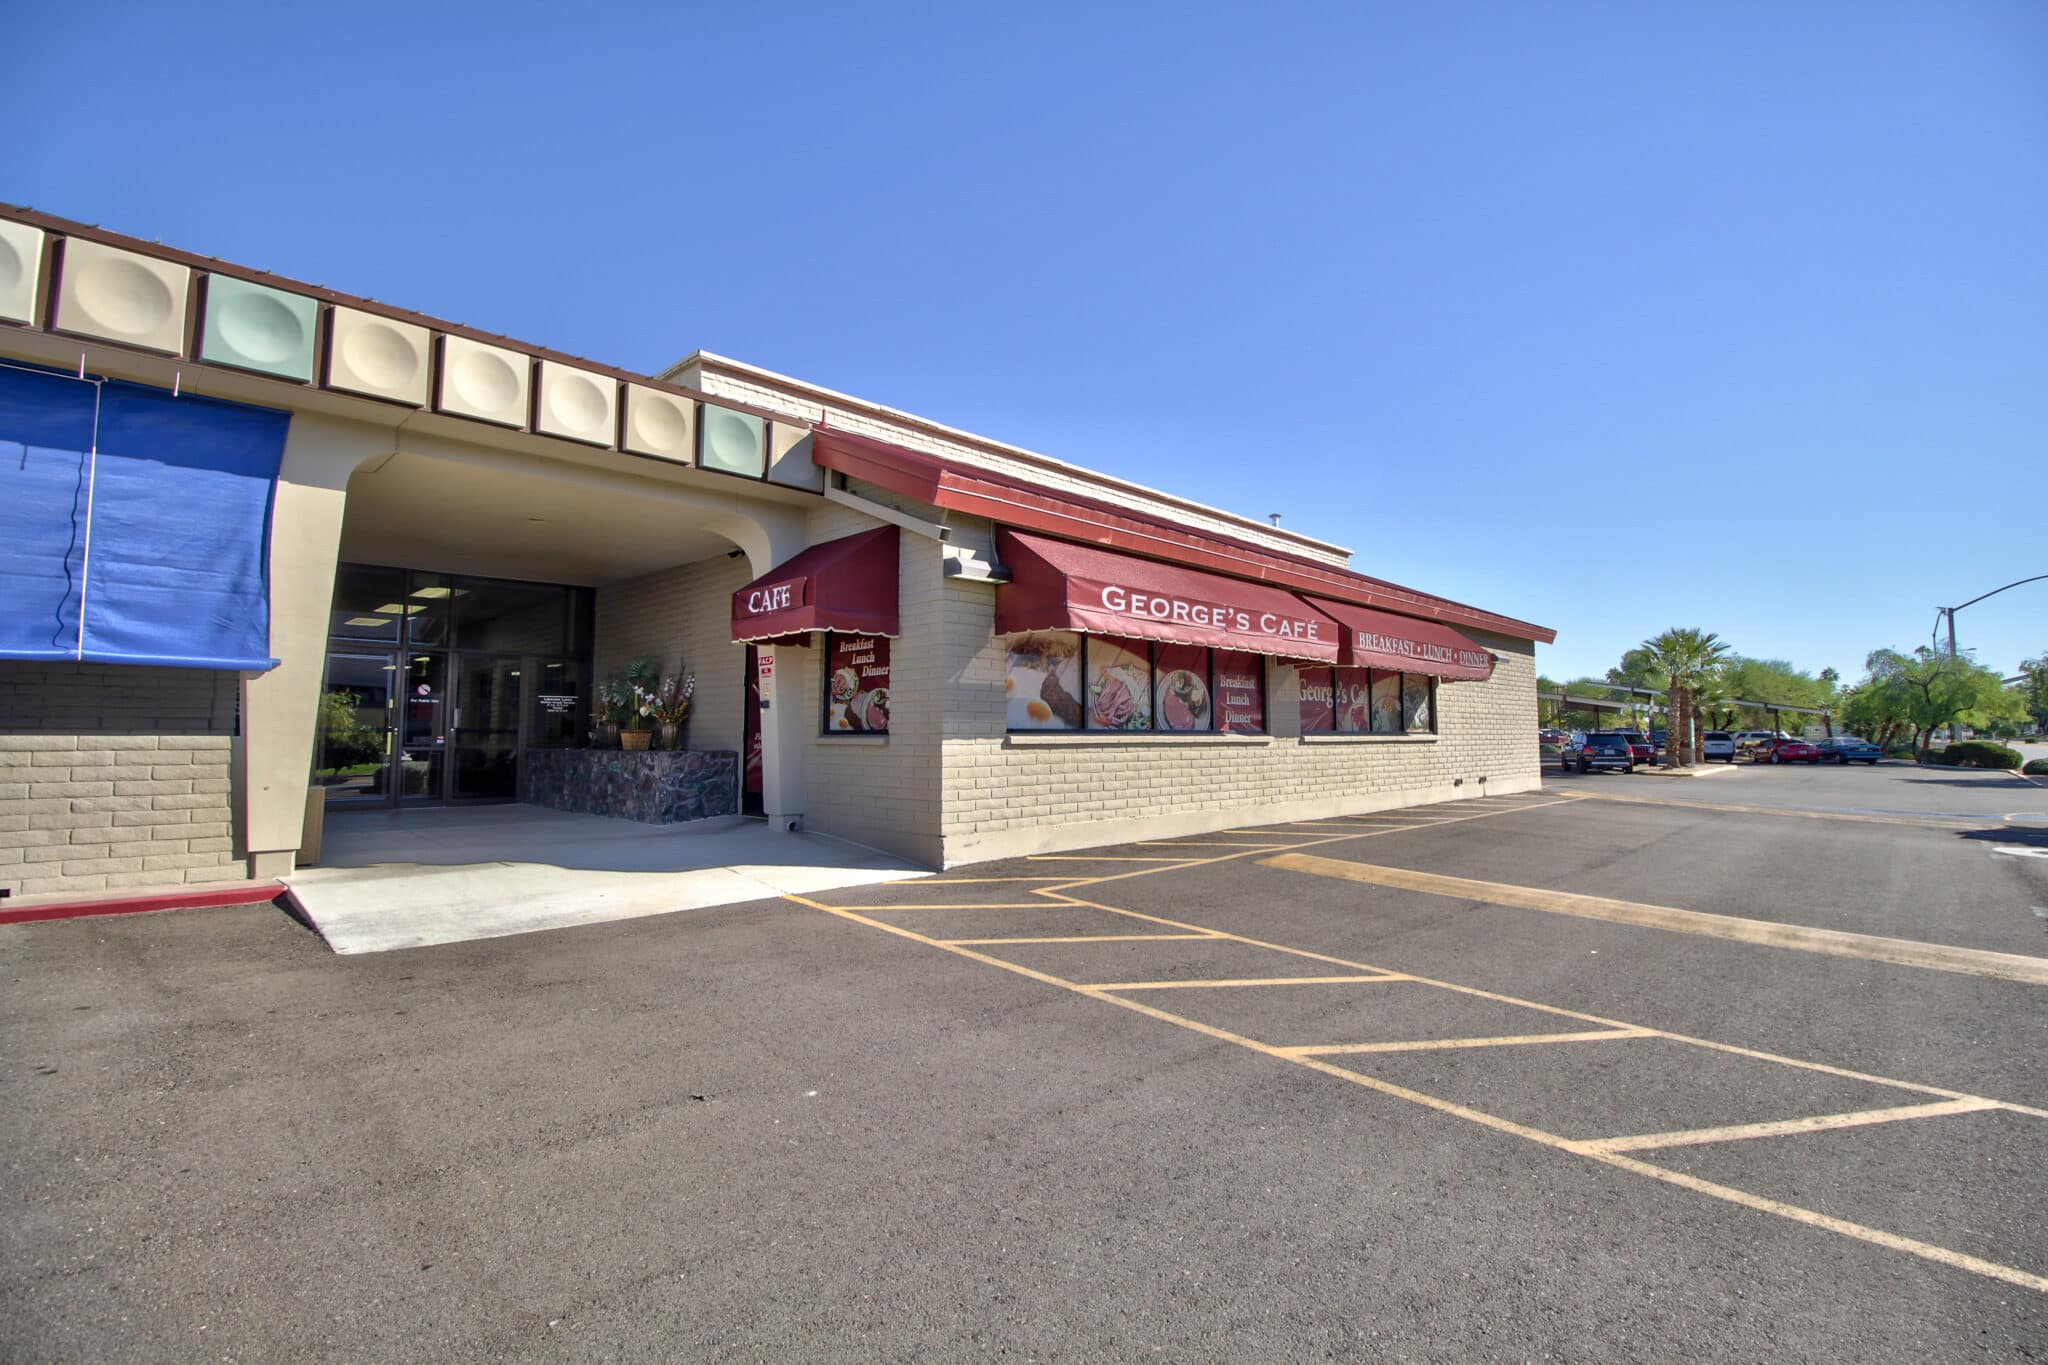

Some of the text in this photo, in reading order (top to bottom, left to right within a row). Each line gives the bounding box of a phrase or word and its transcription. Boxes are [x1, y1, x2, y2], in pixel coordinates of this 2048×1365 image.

[1101, 585, 1319, 641] GEORGE'S CAFÉ
[840, 638, 875, 653] Breakfast
[1358, 631, 1489, 668] BREAKFAST LUNCH DINNER
[851, 651, 875, 665] Lunch
[862, 665, 890, 677] Dinner
[1220, 674, 1256, 689] Breakfast
[1226, 691, 1250, 706] Lunch
[1225, 710, 1251, 723] Dinner
